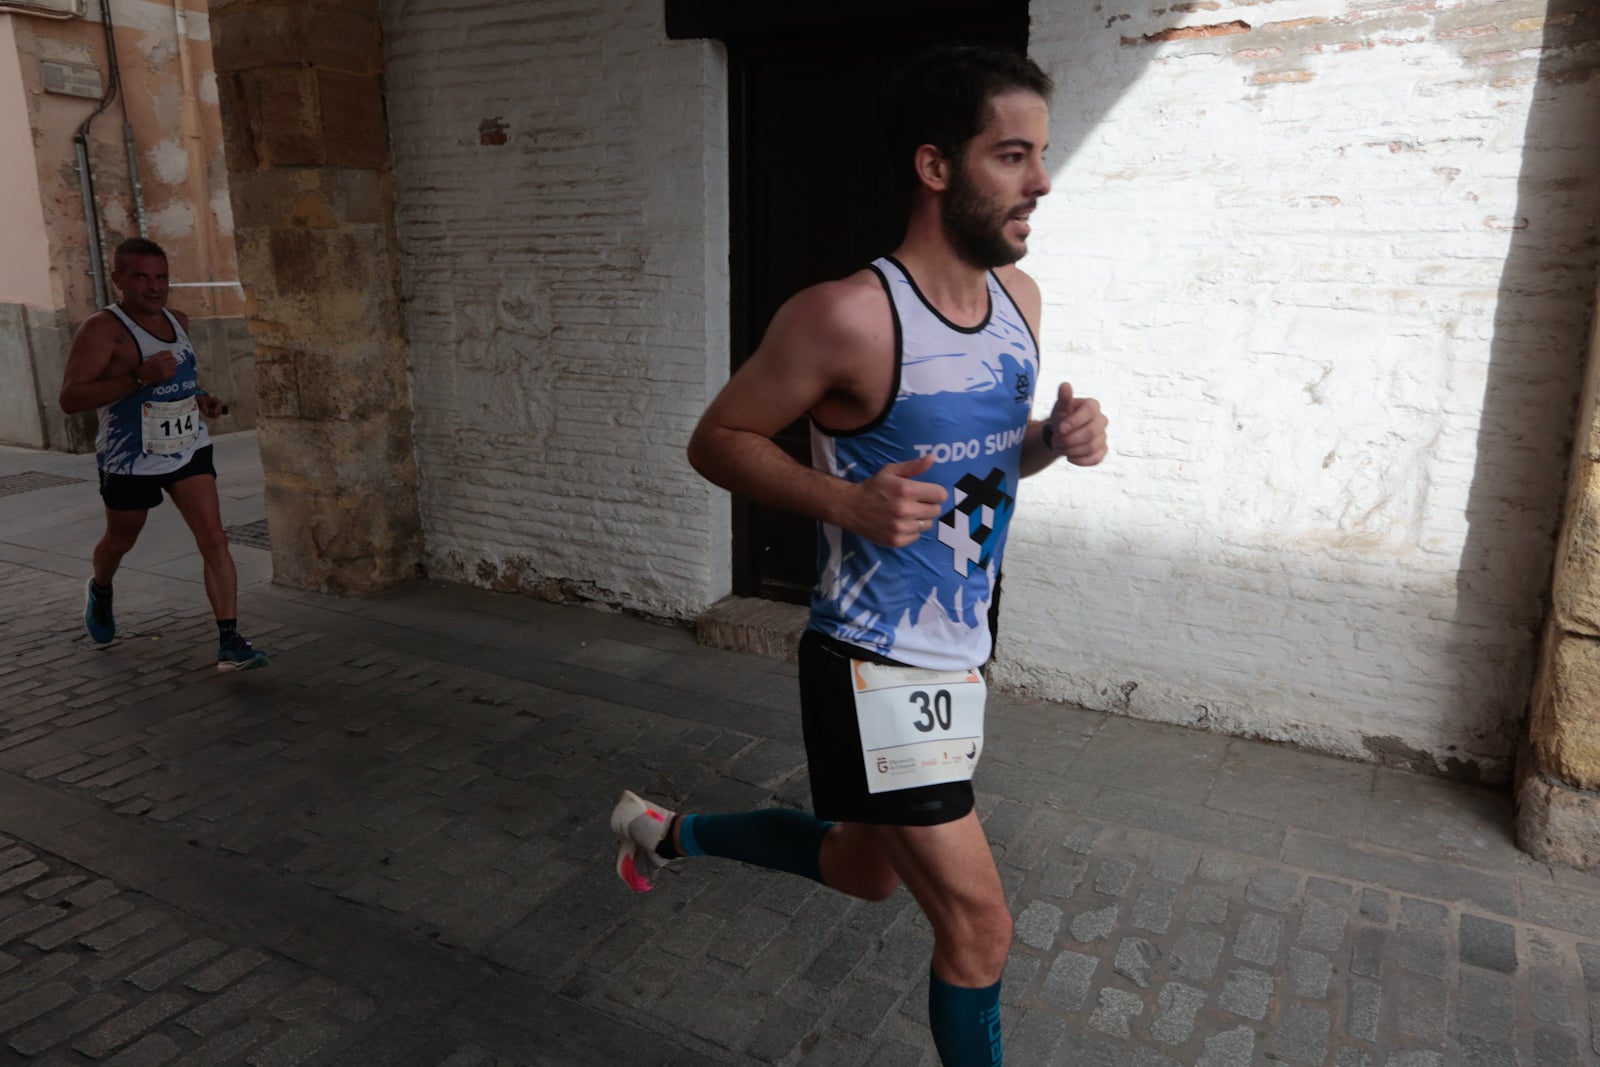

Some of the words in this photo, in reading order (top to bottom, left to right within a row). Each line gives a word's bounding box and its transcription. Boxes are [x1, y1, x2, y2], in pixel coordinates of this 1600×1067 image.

[160, 415, 193, 437] 114
[913, 438, 980, 464] TODO
[909, 689, 952, 733] 30
